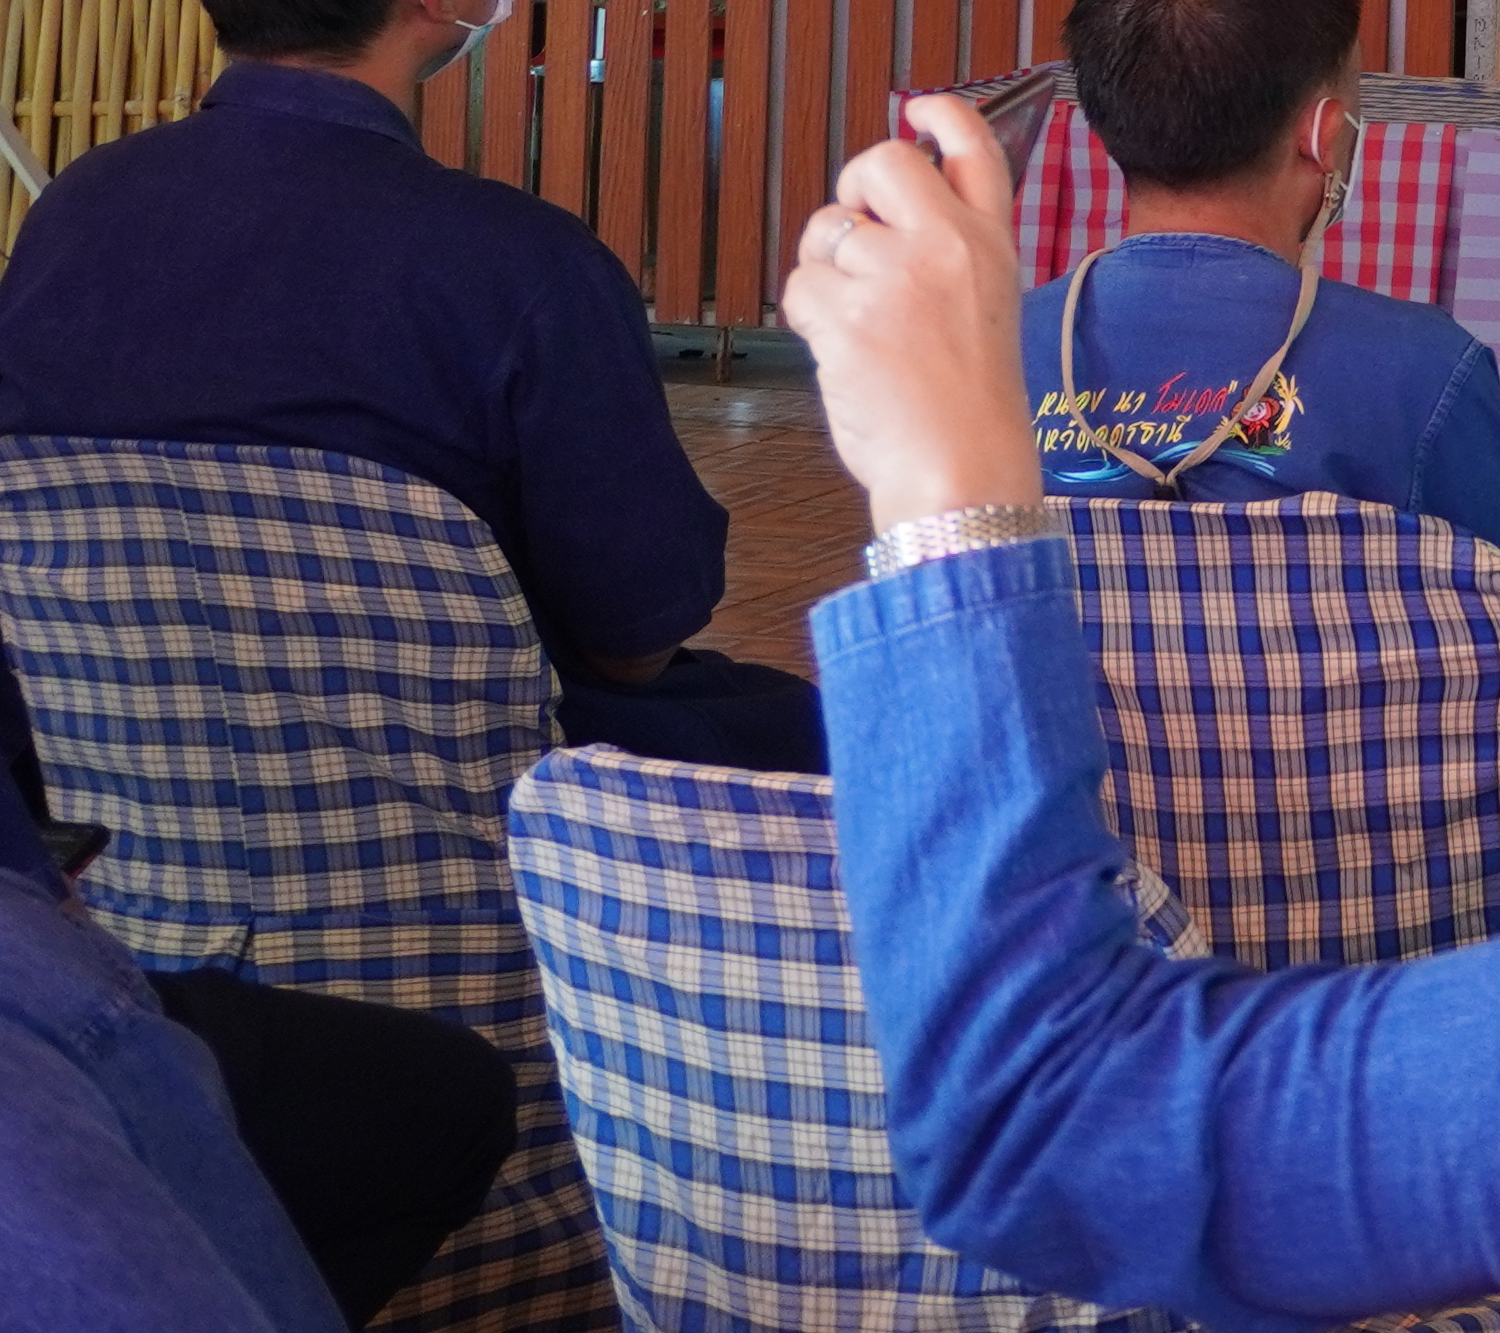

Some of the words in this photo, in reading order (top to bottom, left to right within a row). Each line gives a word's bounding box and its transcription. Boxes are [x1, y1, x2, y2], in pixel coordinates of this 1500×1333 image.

[1036, 414, 1193, 461] หวัดอุดรธานี
